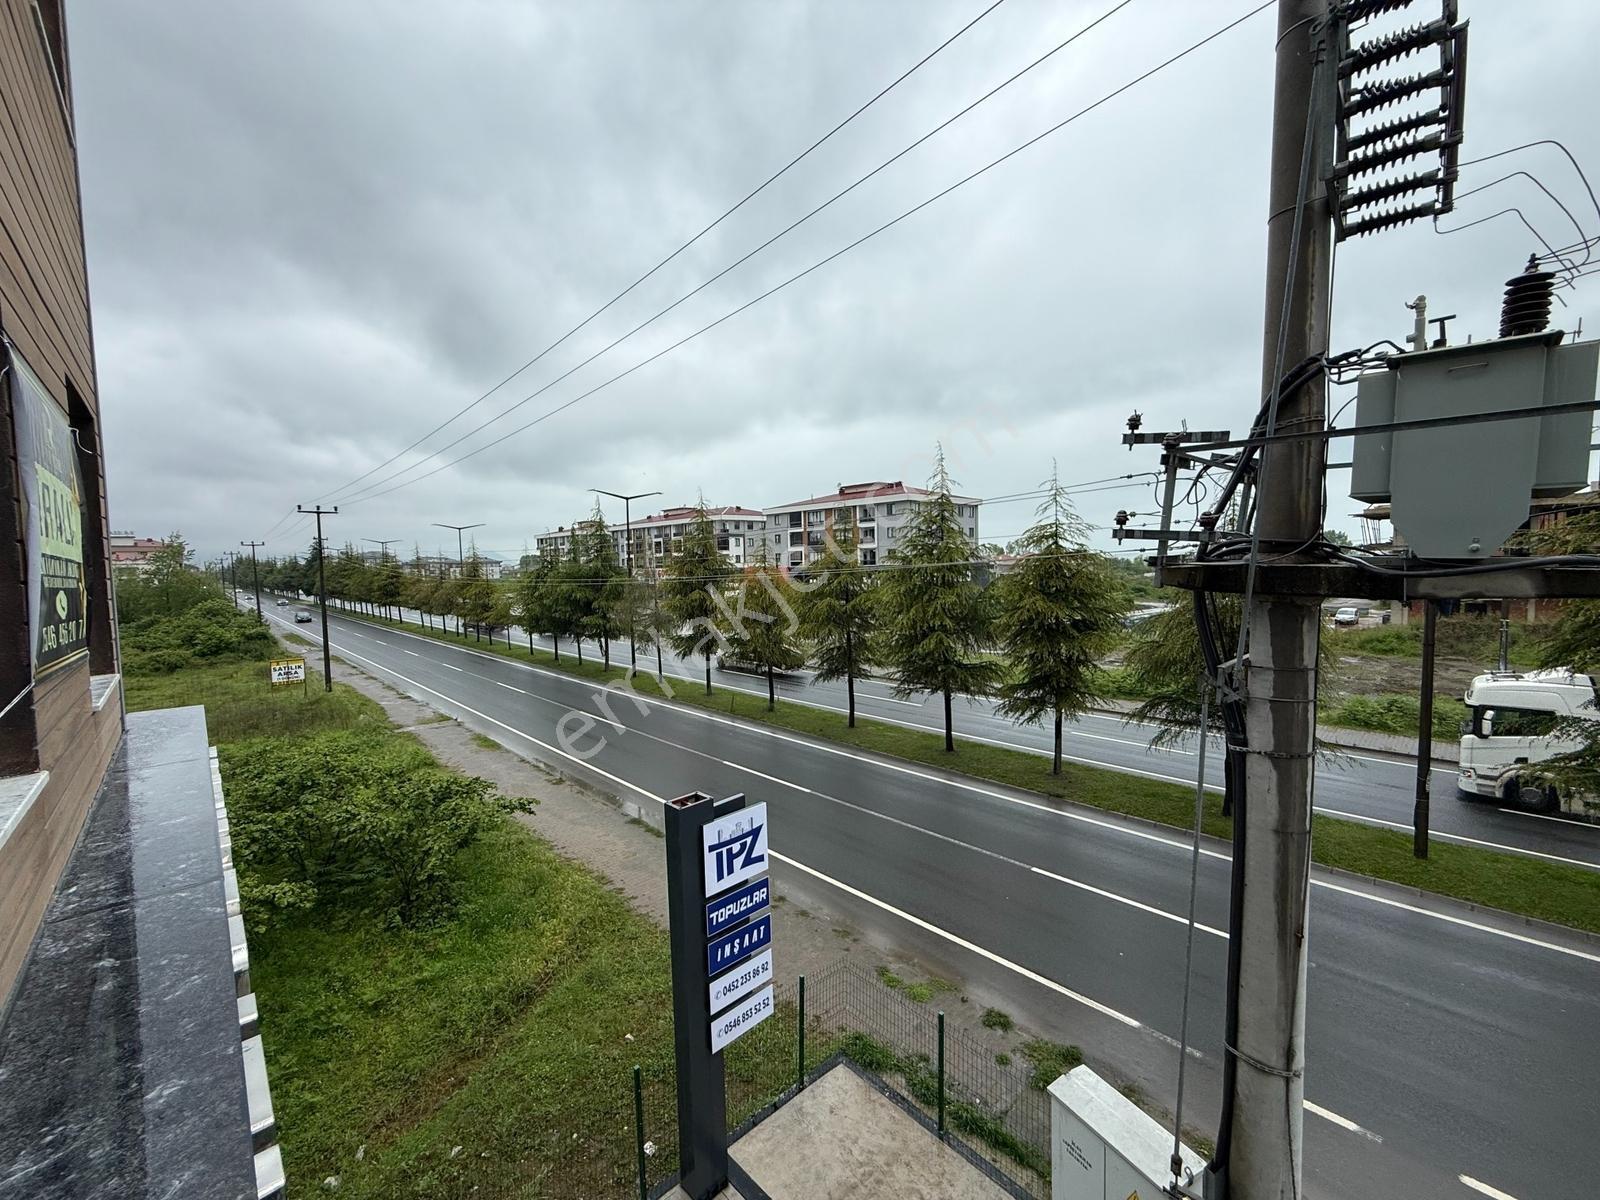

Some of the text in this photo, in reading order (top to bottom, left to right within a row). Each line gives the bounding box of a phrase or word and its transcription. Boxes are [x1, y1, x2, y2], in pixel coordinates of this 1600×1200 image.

[708, 823, 765, 883] TPZ
[709, 887, 768, 925] TOPUZLAR
[723, 981, 739, 997] 0452
[740, 972, 752, 987] 233
[761, 961, 769, 974] 92
[724, 996, 770, 1035] 0546 853 52 52
